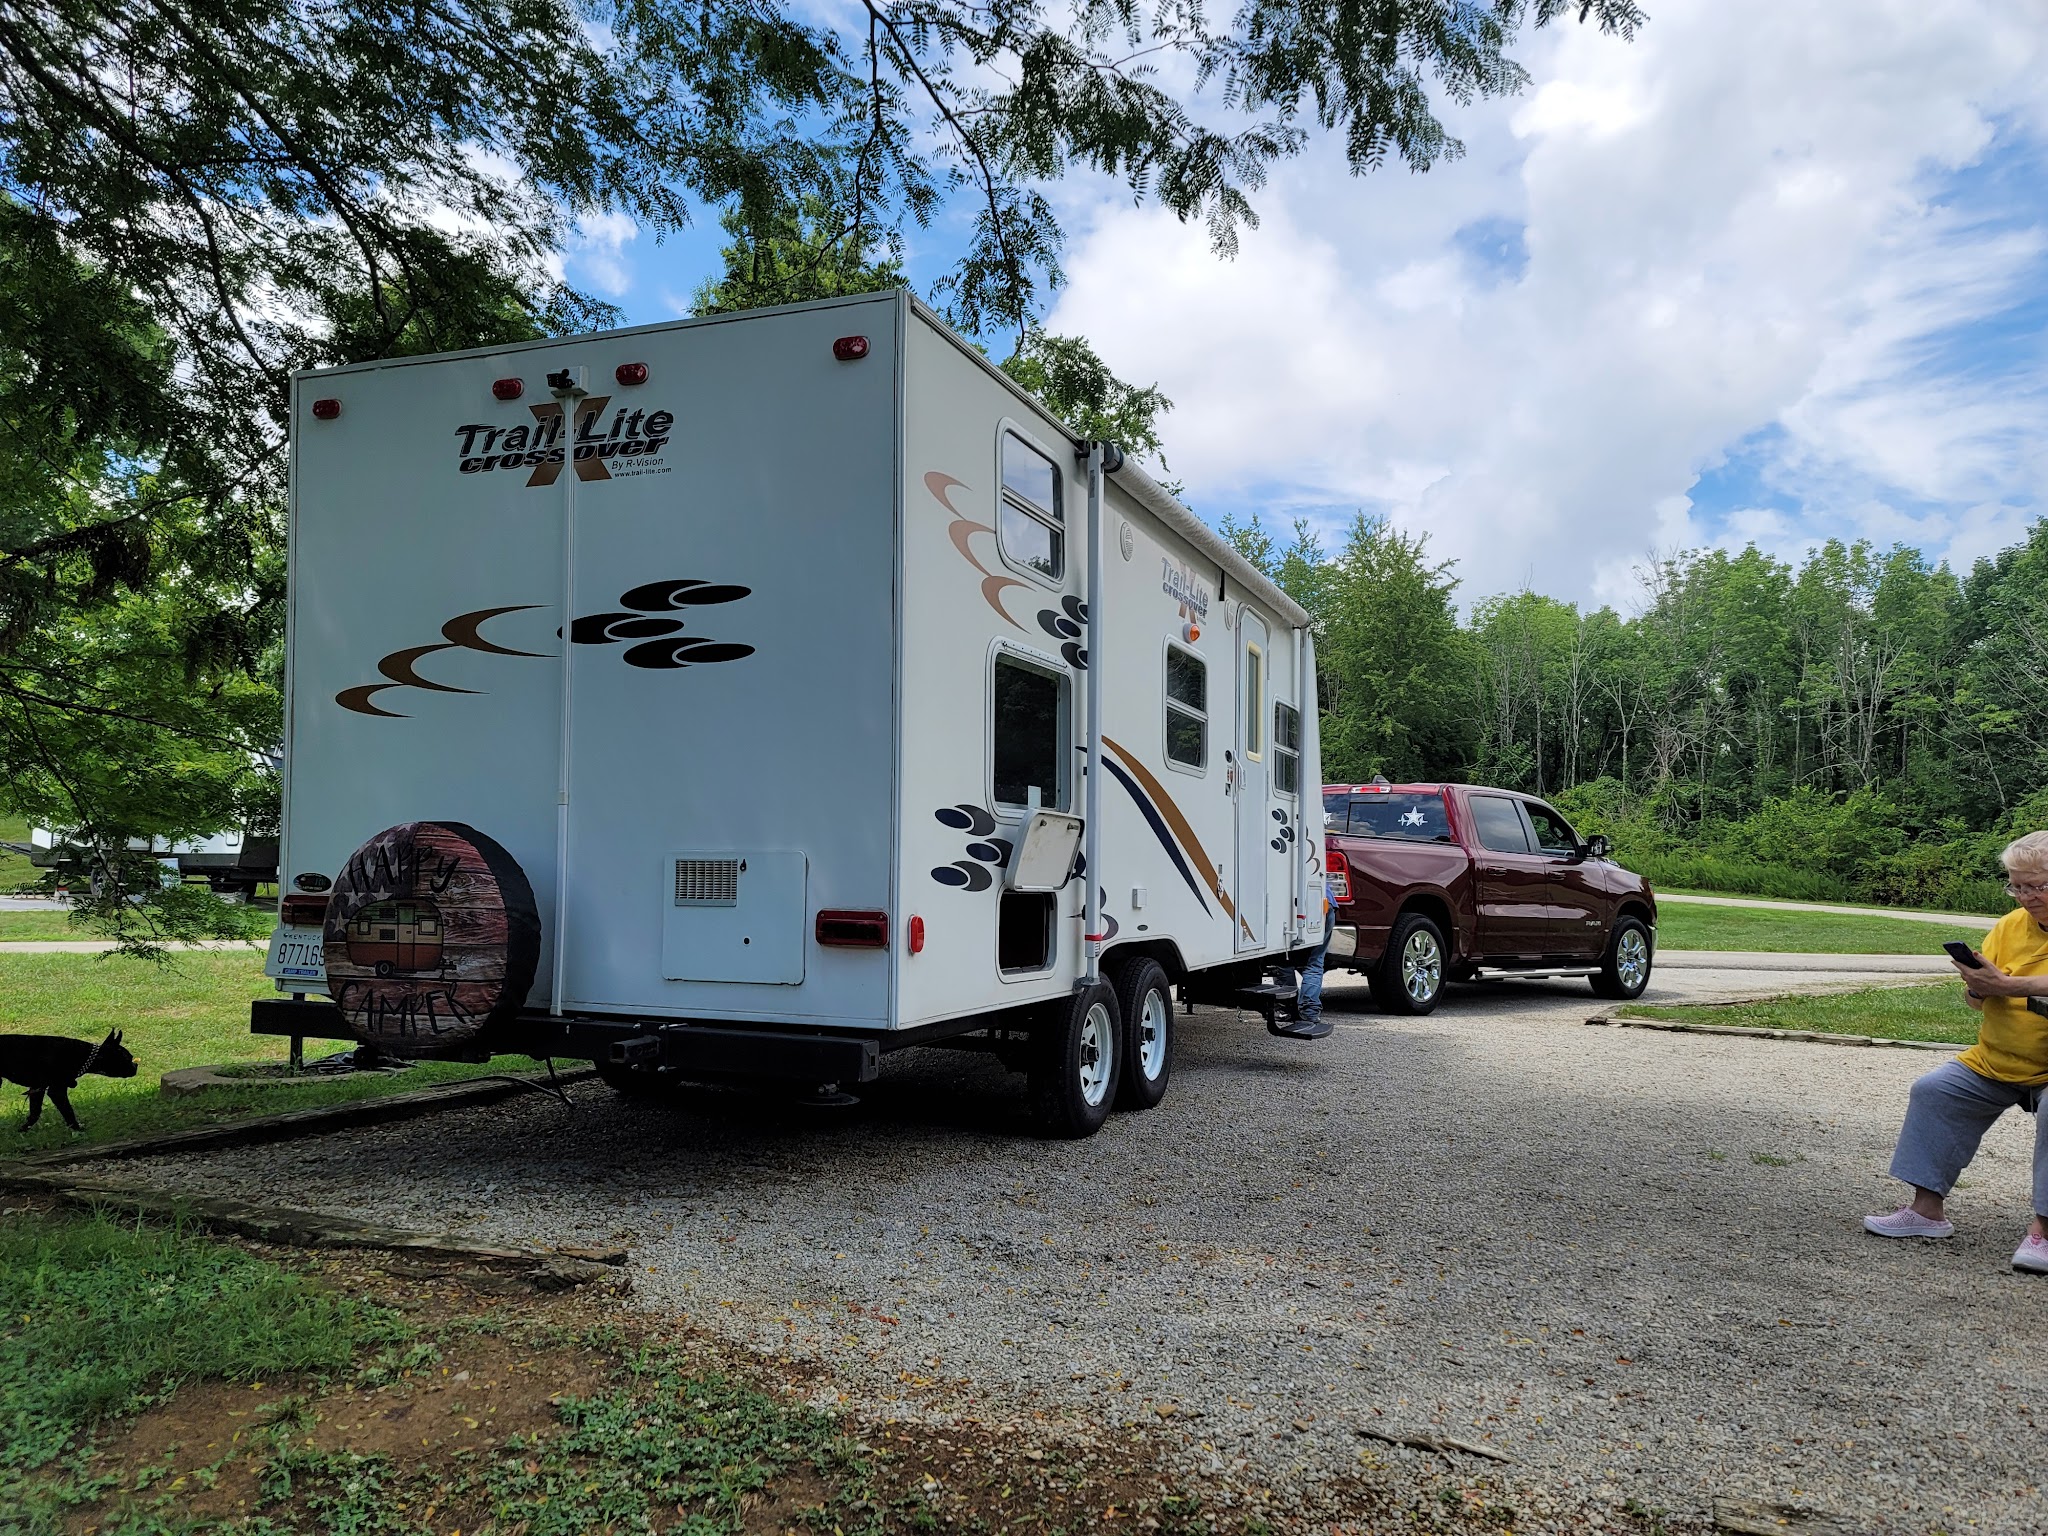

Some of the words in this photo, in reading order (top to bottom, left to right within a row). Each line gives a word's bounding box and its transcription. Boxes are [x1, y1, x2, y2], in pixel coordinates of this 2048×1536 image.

[455, 408, 674, 458] Trail-Lite
[459, 436, 670, 475] crossover
[611, 460, 624, 471] By
[626, 458, 664, 468] R-Vision
[614, 467, 672, 477] www.trail-lite.com
[1160, 557, 1209, 608] Trail-Lite
[1162, 582, 1207, 618] crossover
[288, 933, 323, 941] KENTUCK
[339, 979, 476, 1038] CAMPER
